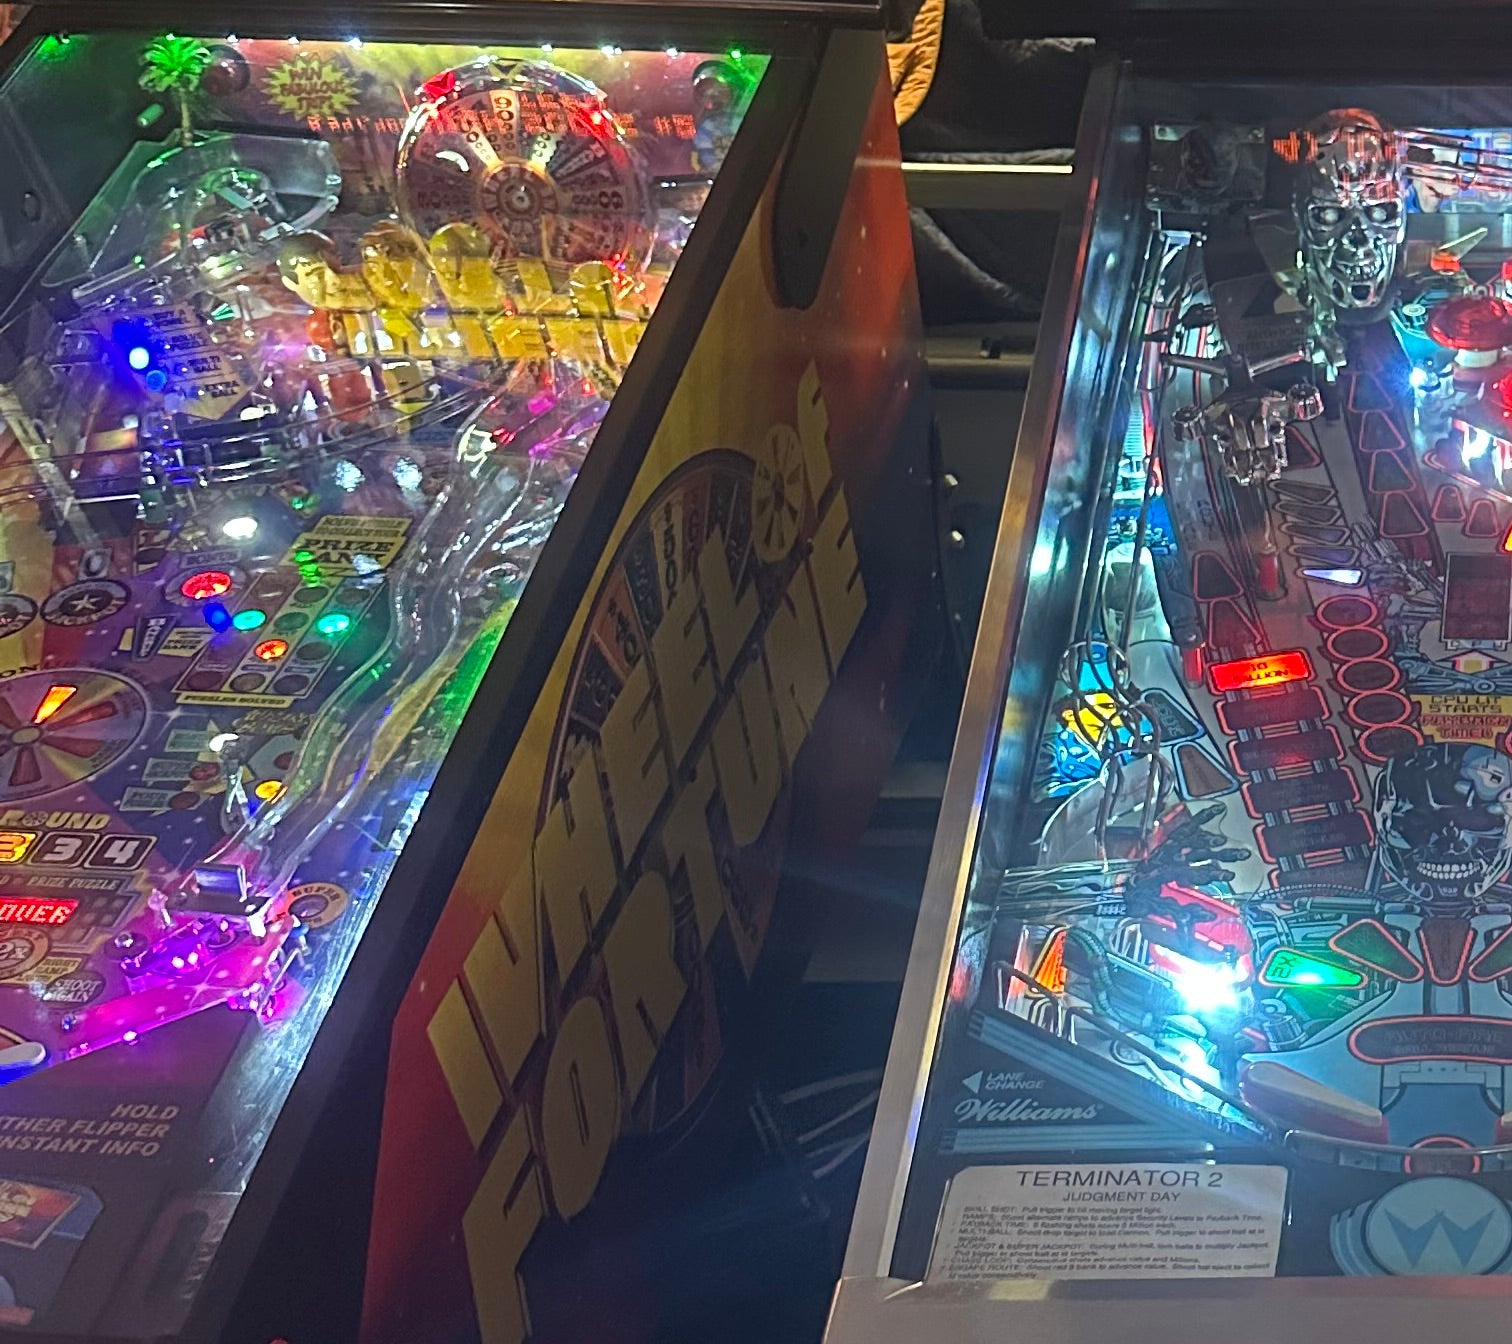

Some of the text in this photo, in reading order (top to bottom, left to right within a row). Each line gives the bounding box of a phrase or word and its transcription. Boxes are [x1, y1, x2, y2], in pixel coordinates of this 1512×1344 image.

[301, 538, 396, 552] PRIZE
[1430, 695, 1467, 705] CPU
[1429, 704, 1502, 714] STARTS
[45, 837, 141, 865] 3 4
[28, 875, 120, 891] PRIZE PUZZLE
[54, 979, 100, 993] SHOOT
[987, 1072, 1025, 1081] LANE
[985, 1080, 1046, 1090] CHANGE
[111, 1103, 180, 1120] HOLD
[954, 1098, 1097, 1123] Williams
[69, 1120, 171, 1139] FLIPPER
[100, 1139, 161, 1157] INFO
[1016, 1169, 1225, 1189] TERMINATOR 2
[1062, 1190, 1181, 1205] JUDGMENT DAY
